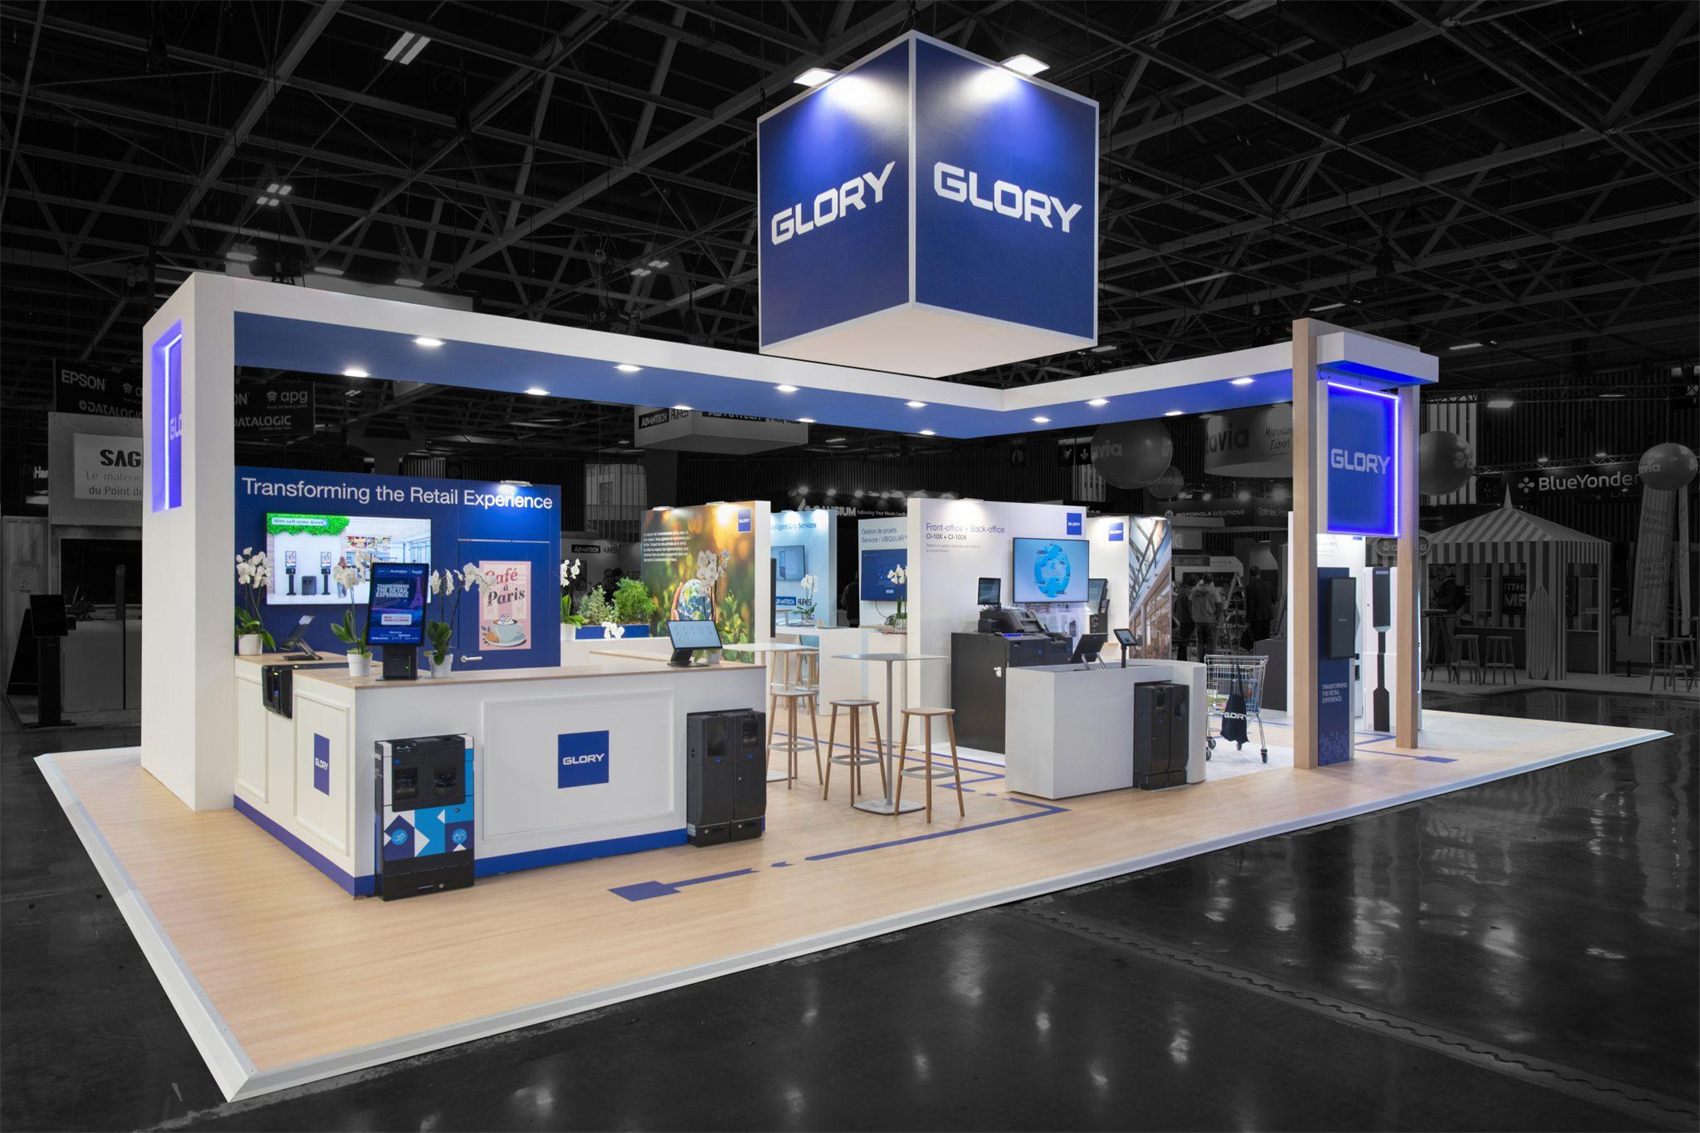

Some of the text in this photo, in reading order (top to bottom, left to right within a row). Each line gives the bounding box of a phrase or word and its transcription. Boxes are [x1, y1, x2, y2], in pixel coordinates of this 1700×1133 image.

[771, 161, 896, 246] GLORY
[934, 161, 1083, 233] GLORY
[61, 368, 106, 392] EPSON
[280, 391, 308, 404] apg
[99, 448, 143, 468] SAG
[1330, 448, 1391, 475] GLORY
[105, 485, 130, 496] Point
[241, 476, 553, 510] Transforming the Retail Experience
[925, 522, 964, 532] Front-office
[971, 524, 1006, 534] Back-office
[487, 587, 526, 607] Paris
[315, 757, 329, 771] GLORY
[562, 753, 605, 766] GLORY
